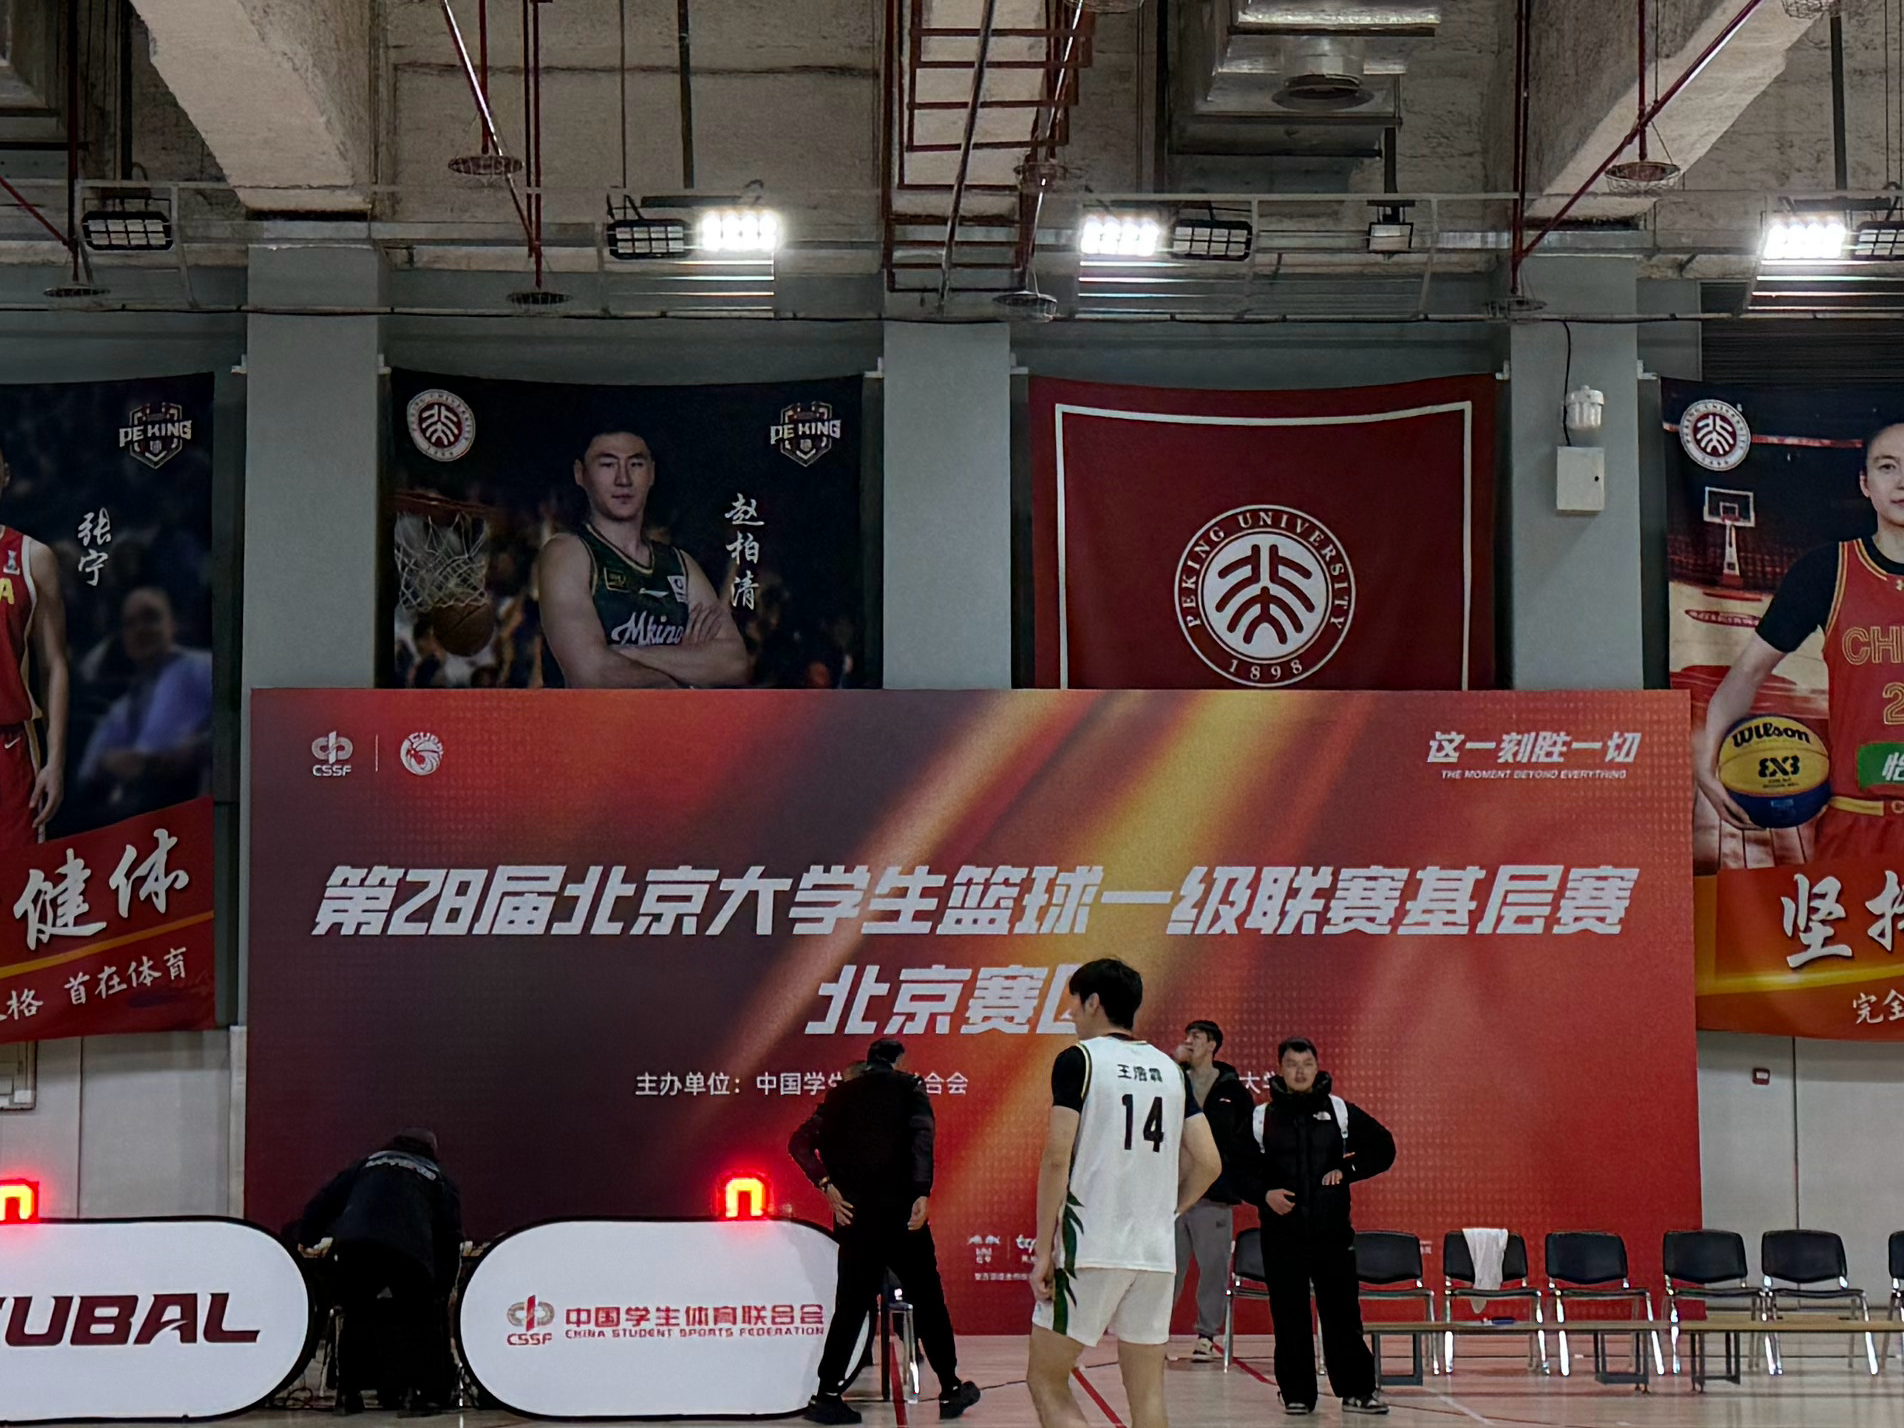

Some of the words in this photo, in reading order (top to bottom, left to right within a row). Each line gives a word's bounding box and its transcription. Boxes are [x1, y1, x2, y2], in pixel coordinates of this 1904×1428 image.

[77, 507, 113, 586] 张宁
[724, 492, 765, 612] 赵柏清
[1181, 525, 1226, 628] PEKING
[1236, 510, 1350, 630] UNIVERSITY
[1228, 658, 1304, 682] 1898
[1427, 731, 1642, 763] 这一刻胜一切
[1731, 722, 1811, 748] Wilson
[312, 765, 352, 777] CSSF
[311, 864, 1640, 936] 第28届北京大学生篮球一级联赛基层赛
[63, 946, 189, 1006] 首在体育
[1122, 1093, 1165, 1153] 14
[565, 1304, 824, 1328] 中国学生体育联合会
[507, 1332, 553, 1346] CSSF
[565, 1328, 606, 1340] CHINA
[611, 1327, 673, 1339] STUDENT
[679, 1326, 734, 1338] SPORTS
[739, 1325, 825, 1338] FEDERATION
